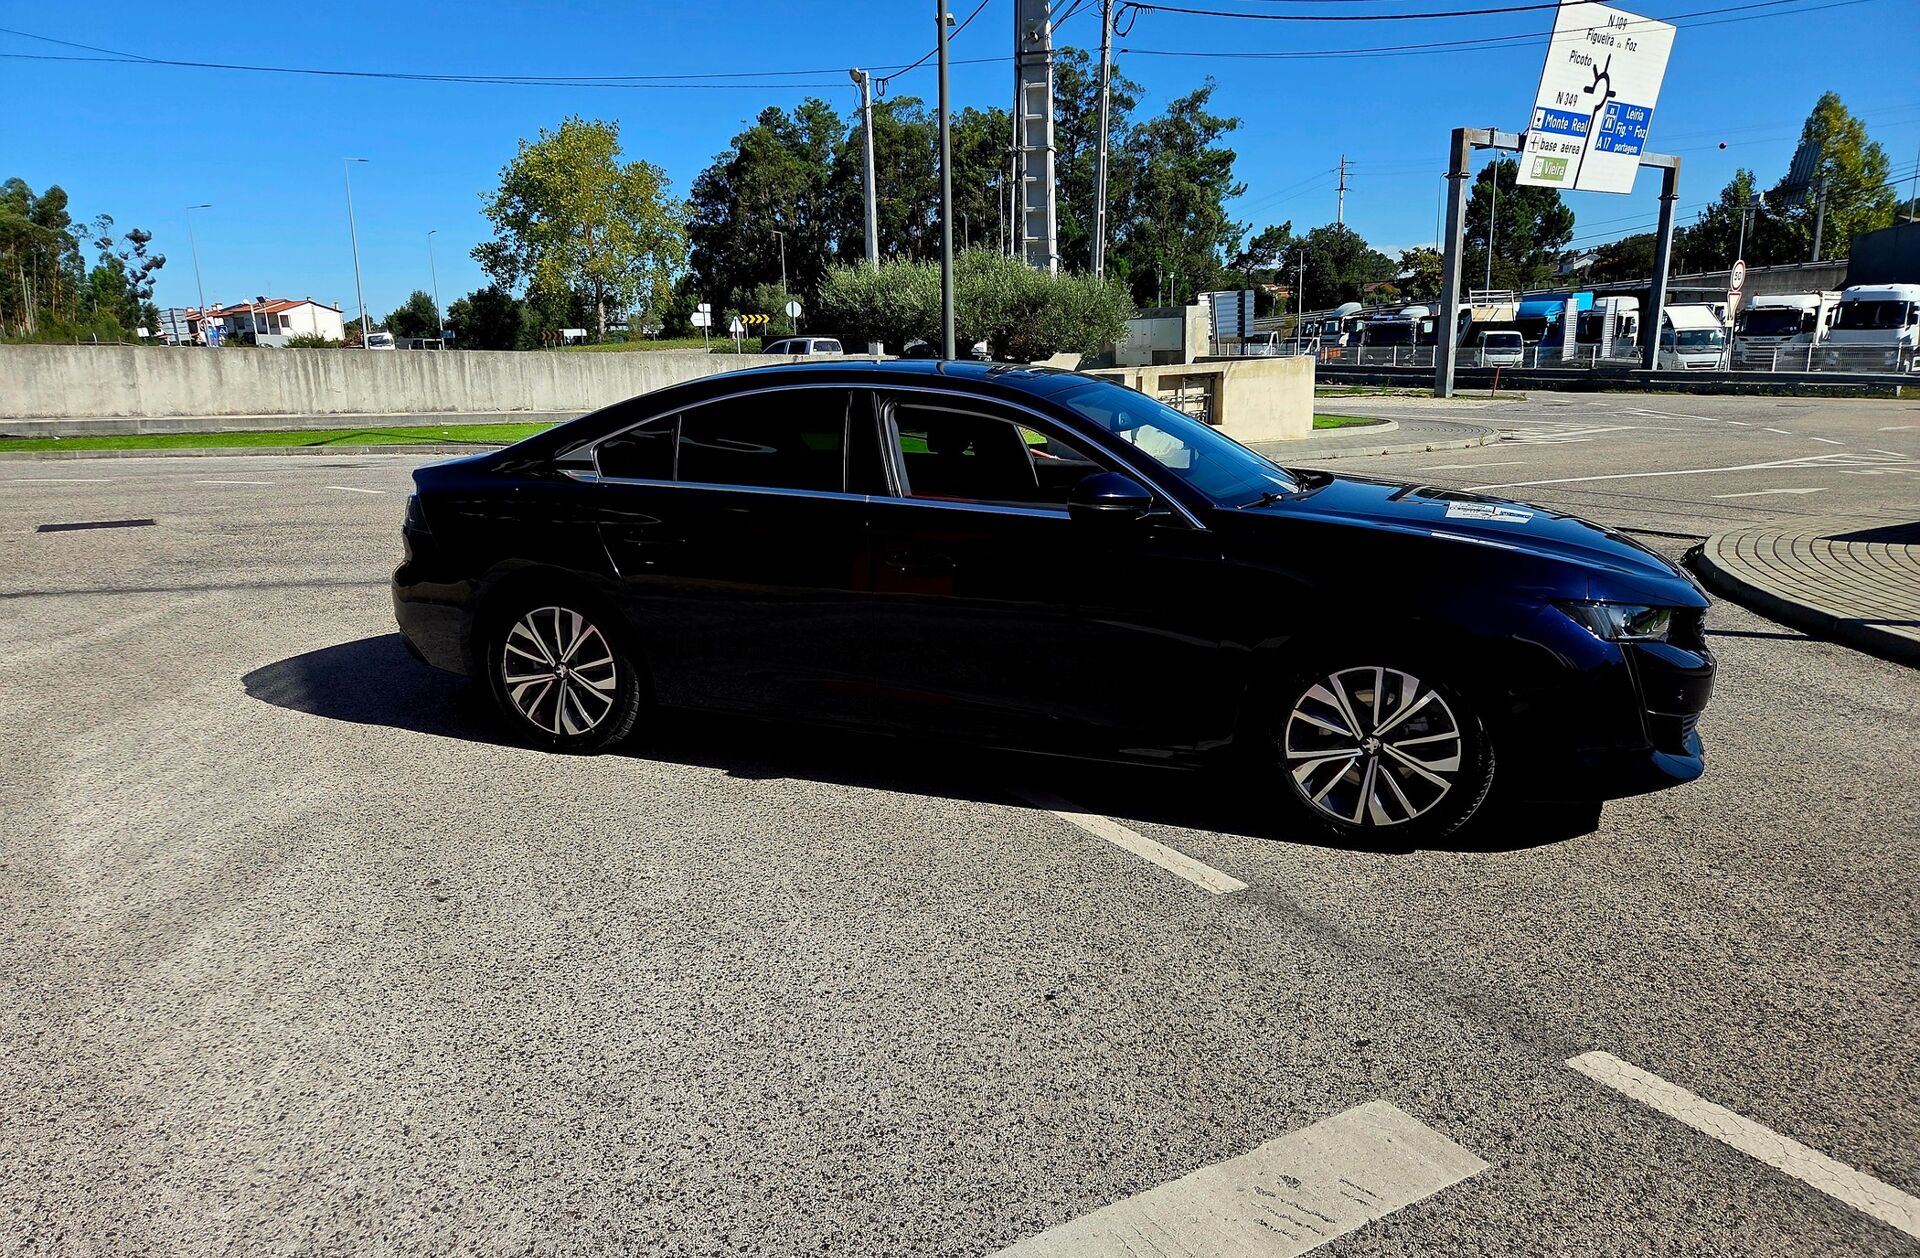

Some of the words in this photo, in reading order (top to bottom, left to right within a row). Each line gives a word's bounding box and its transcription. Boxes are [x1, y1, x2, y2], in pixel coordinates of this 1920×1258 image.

[1586, 28, 1615, 46] Figueira
[1625, 38, 1638, 52] Foz
[1569, 50, 1592, 66] Picoto
[1556, 91, 1563, 104] N
[1564, 93, 1578, 107] 349
[1626, 106, 1644, 121] Leiria
[1545, 114, 1569, 130] Monte
[1571, 118, 1588, 133] Real
[1633, 125, 1646, 138] Foz
[1540, 138, 1557, 152] base
[1560, 141, 1580, 155] aérea
[1613, 142, 1638, 154] portagem
[1544, 161, 1565, 176] Vieira
[1734, 271, 1742, 281] 50
